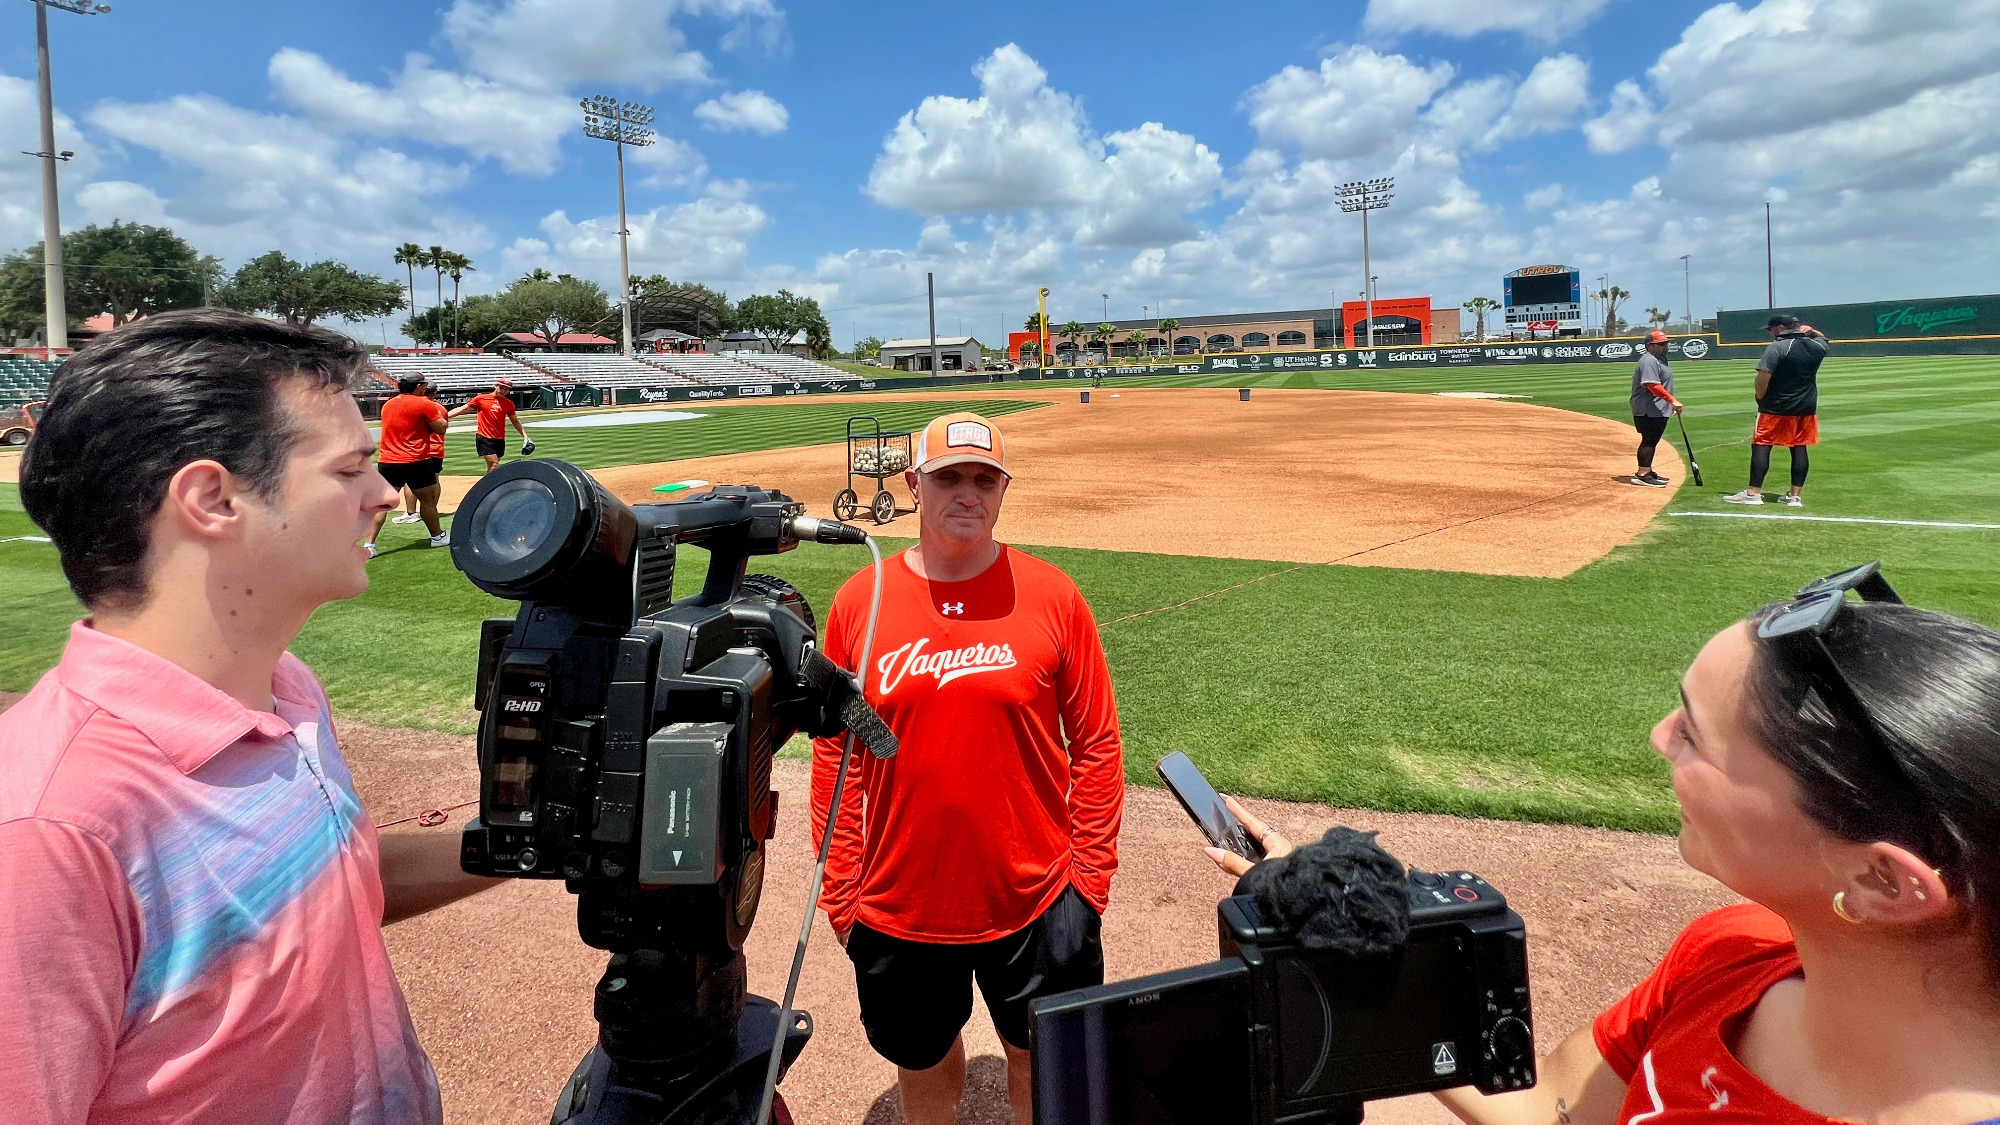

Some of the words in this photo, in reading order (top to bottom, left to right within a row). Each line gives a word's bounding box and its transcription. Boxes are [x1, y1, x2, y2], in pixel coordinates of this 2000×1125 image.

[1877, 307, 1977, 333] Vaqueros
[1388, 352, 1437, 363] Edinburg
[1485, 348, 1506, 357] WING
[1518, 347, 1538, 357] BARN
[1295, 355, 1317, 363] Health
[1320, 354, 1332, 364] 5
[949, 426, 989, 441] UTRGV
[878, 638, 1017, 695] Vaqueros
[505, 700, 541, 712] P2HD
[667, 790, 677, 834] Panasonic
